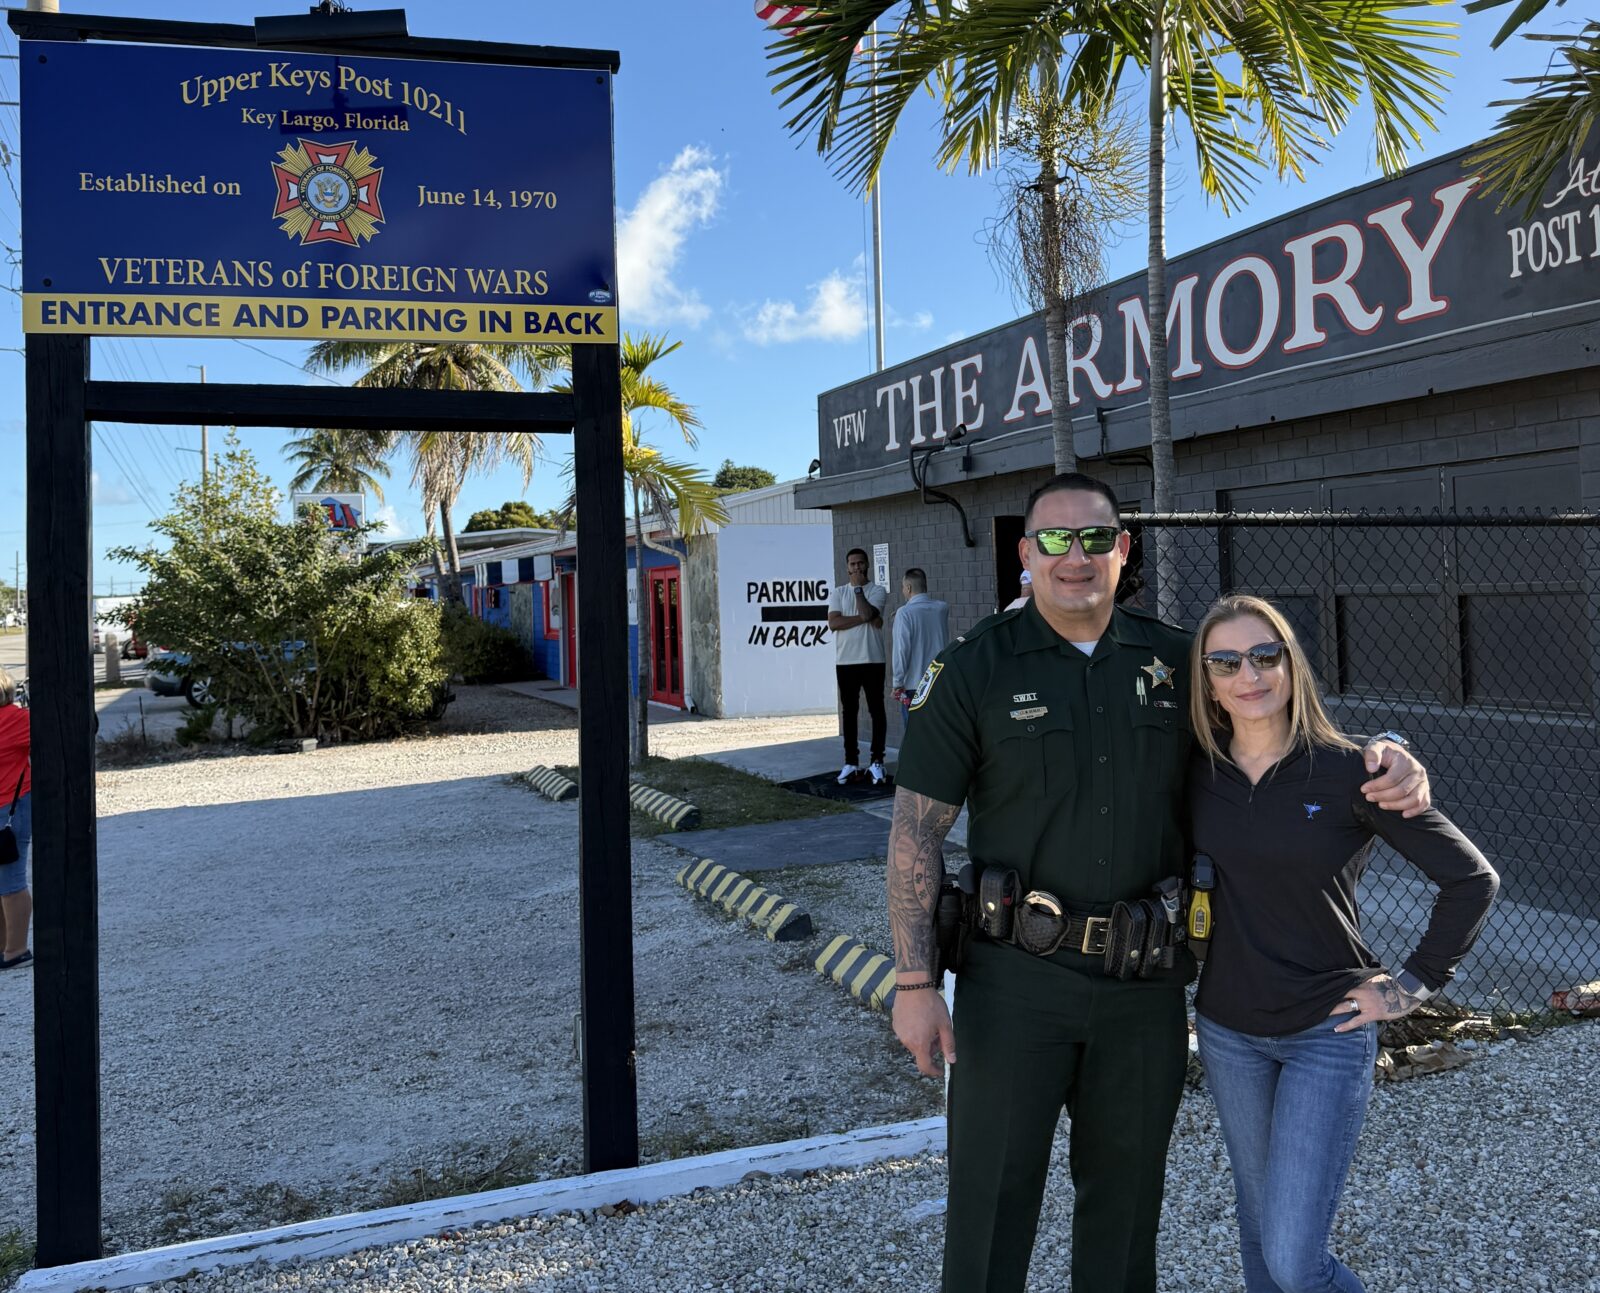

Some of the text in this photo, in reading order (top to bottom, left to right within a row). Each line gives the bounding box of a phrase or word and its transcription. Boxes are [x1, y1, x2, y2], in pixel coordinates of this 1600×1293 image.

[180, 62, 467, 136] Upper Keys Post 10211
[241, 108, 410, 132] Key Largo, Florida
[79, 172, 242, 195] Established on
[300, 169, 317, 193] VETERANS
[417, 185, 557, 209] June 14, 1970
[1507, 210, 1582, 278] POST
[98, 257, 548, 295] VETERANS of FOREIGN WARS
[41, 301, 605, 335] ENTRANCE AND PARKING IN BACK
[833, 176, 1483, 451] VFW THE ARMORY
[747, 580, 829, 603] PARKING
[748, 624, 831, 648] IN BACK
[1013, 692, 1038, 703] SWAT
